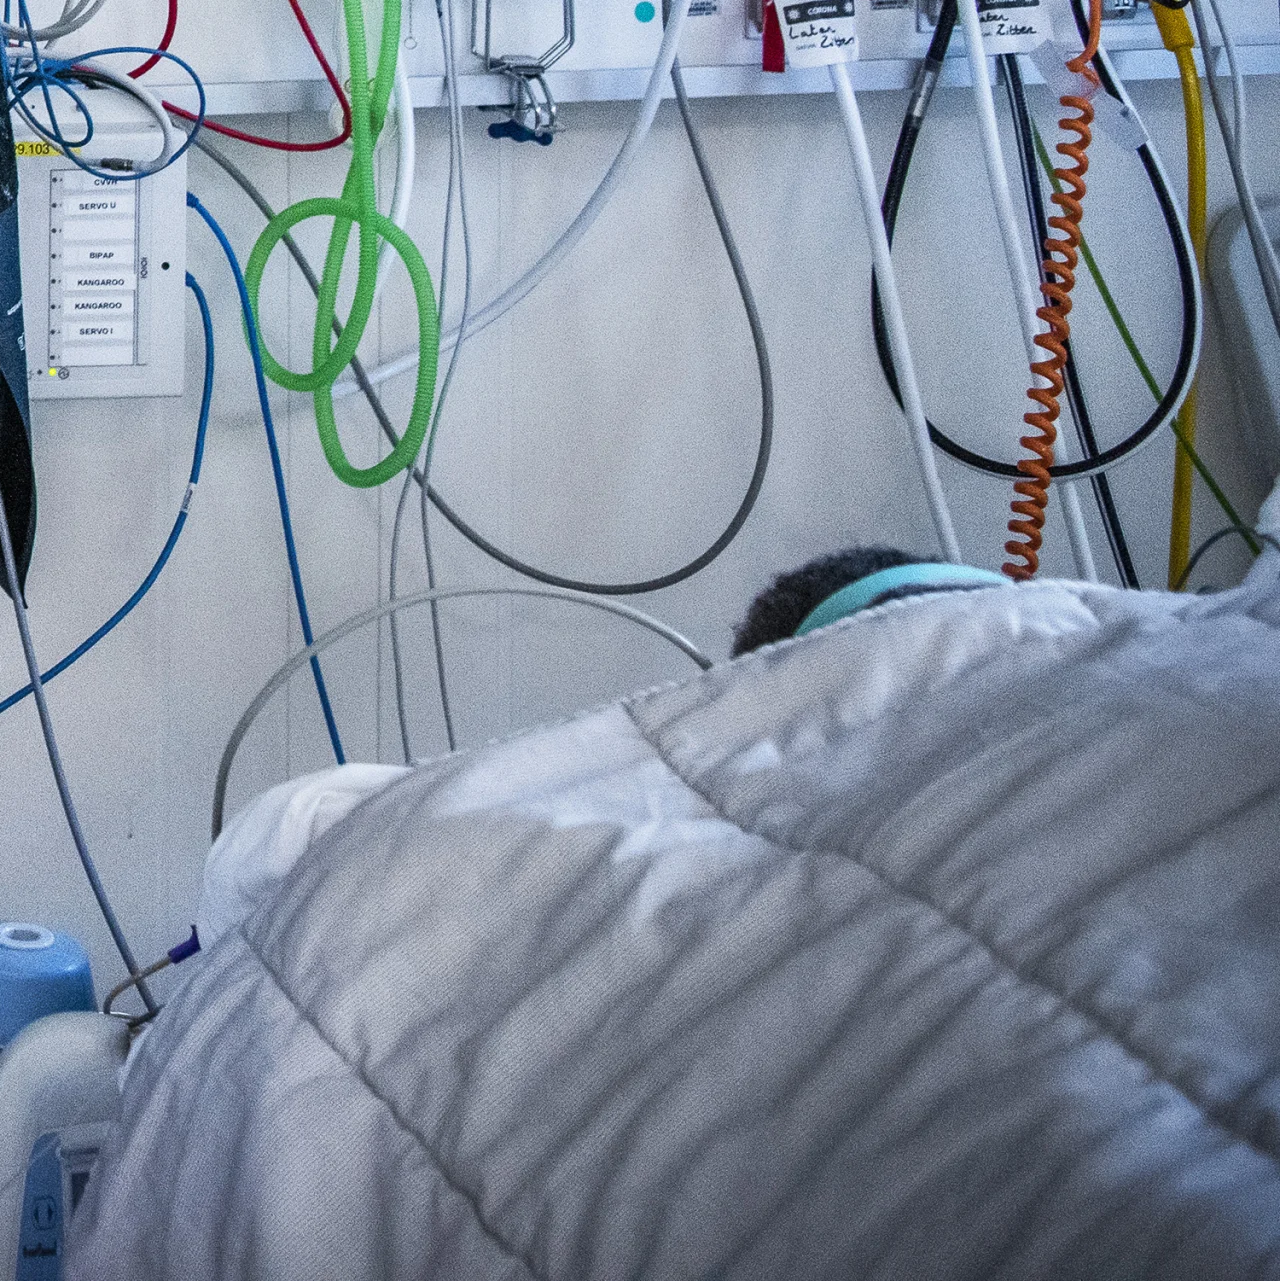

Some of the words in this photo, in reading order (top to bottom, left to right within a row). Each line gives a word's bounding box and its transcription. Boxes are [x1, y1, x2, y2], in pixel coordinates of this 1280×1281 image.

[807, 5, 838, 15] CORONA
[979, 12, 1009, 24] aten
[995, 23, 1037, 36] Zitten
[78, 202, 108, 211] SERVO
[109, 201, 117, 209] U
[89, 251, 114, 260] BIPAP
[77, 277, 125, 288] KANGAROO
[74, 301, 123, 311] KANGAROO
[78, 327, 108, 336] SERVO
